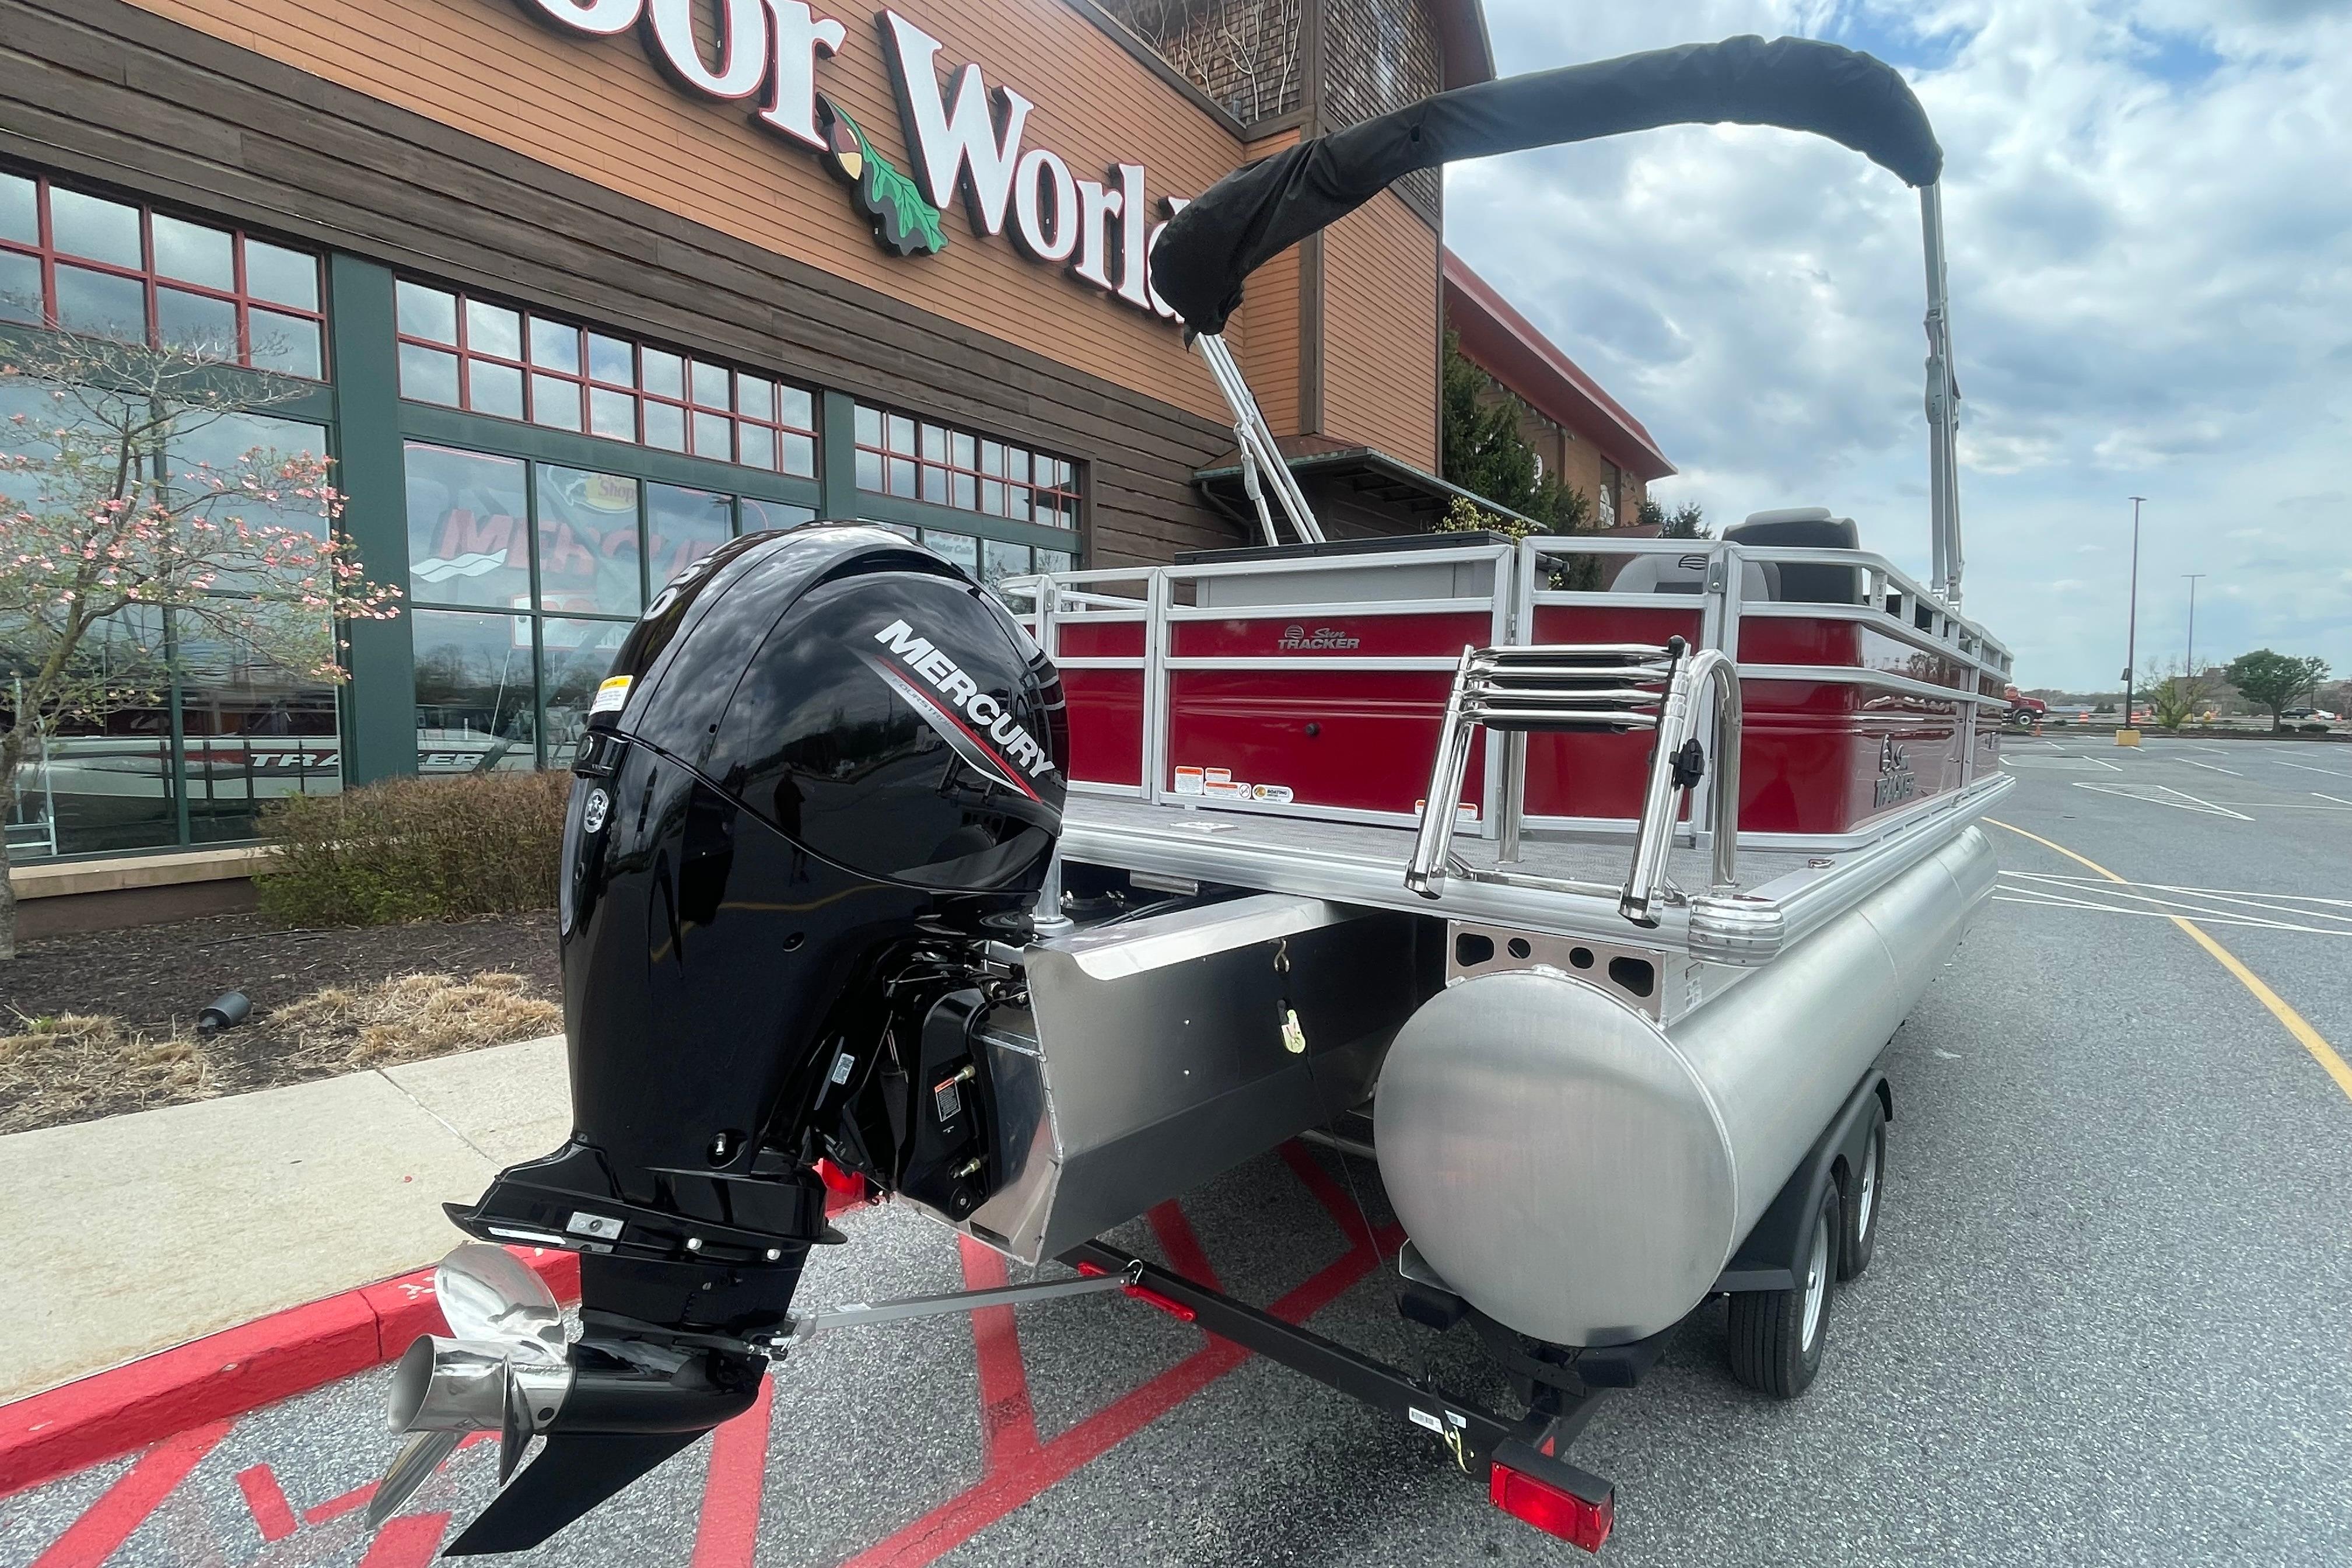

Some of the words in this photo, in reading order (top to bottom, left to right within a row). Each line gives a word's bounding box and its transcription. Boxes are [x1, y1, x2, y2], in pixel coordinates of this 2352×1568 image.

[534, 0, 848, 151] or
[886, 9, 1191, 323] Worl
[1278, 638, 1360, 649] TRACKER
[1310, 628, 1346, 638] Sun
[874, 619, 1055, 778] MERCURY
